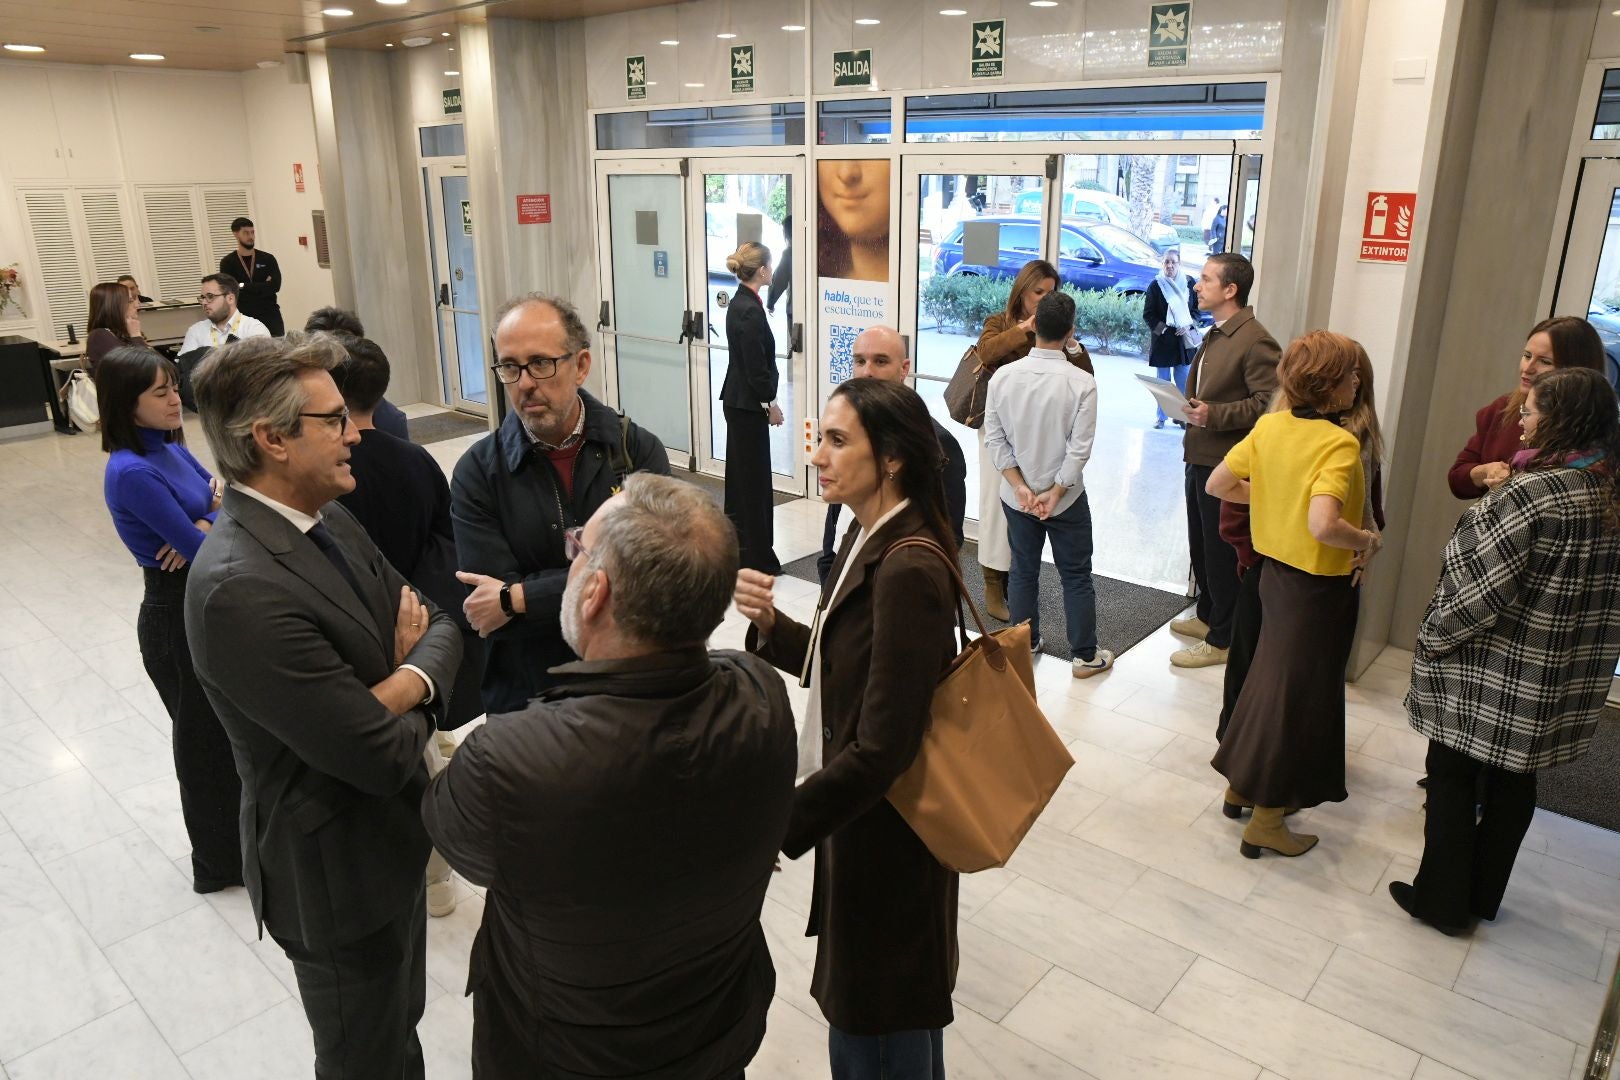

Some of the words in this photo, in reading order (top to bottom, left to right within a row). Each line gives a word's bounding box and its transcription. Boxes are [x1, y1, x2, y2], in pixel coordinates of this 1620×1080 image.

[834, 60, 870, 77] SALIDA
[443, 95, 461, 107] SALIDA
[1361, 245, 1407, 257] EXTINTOR
[824, 289, 852, 305] habla,
[853, 296, 872, 307] que
[874, 296, 885, 306] te
[824, 304, 885, 318] escuchamos
